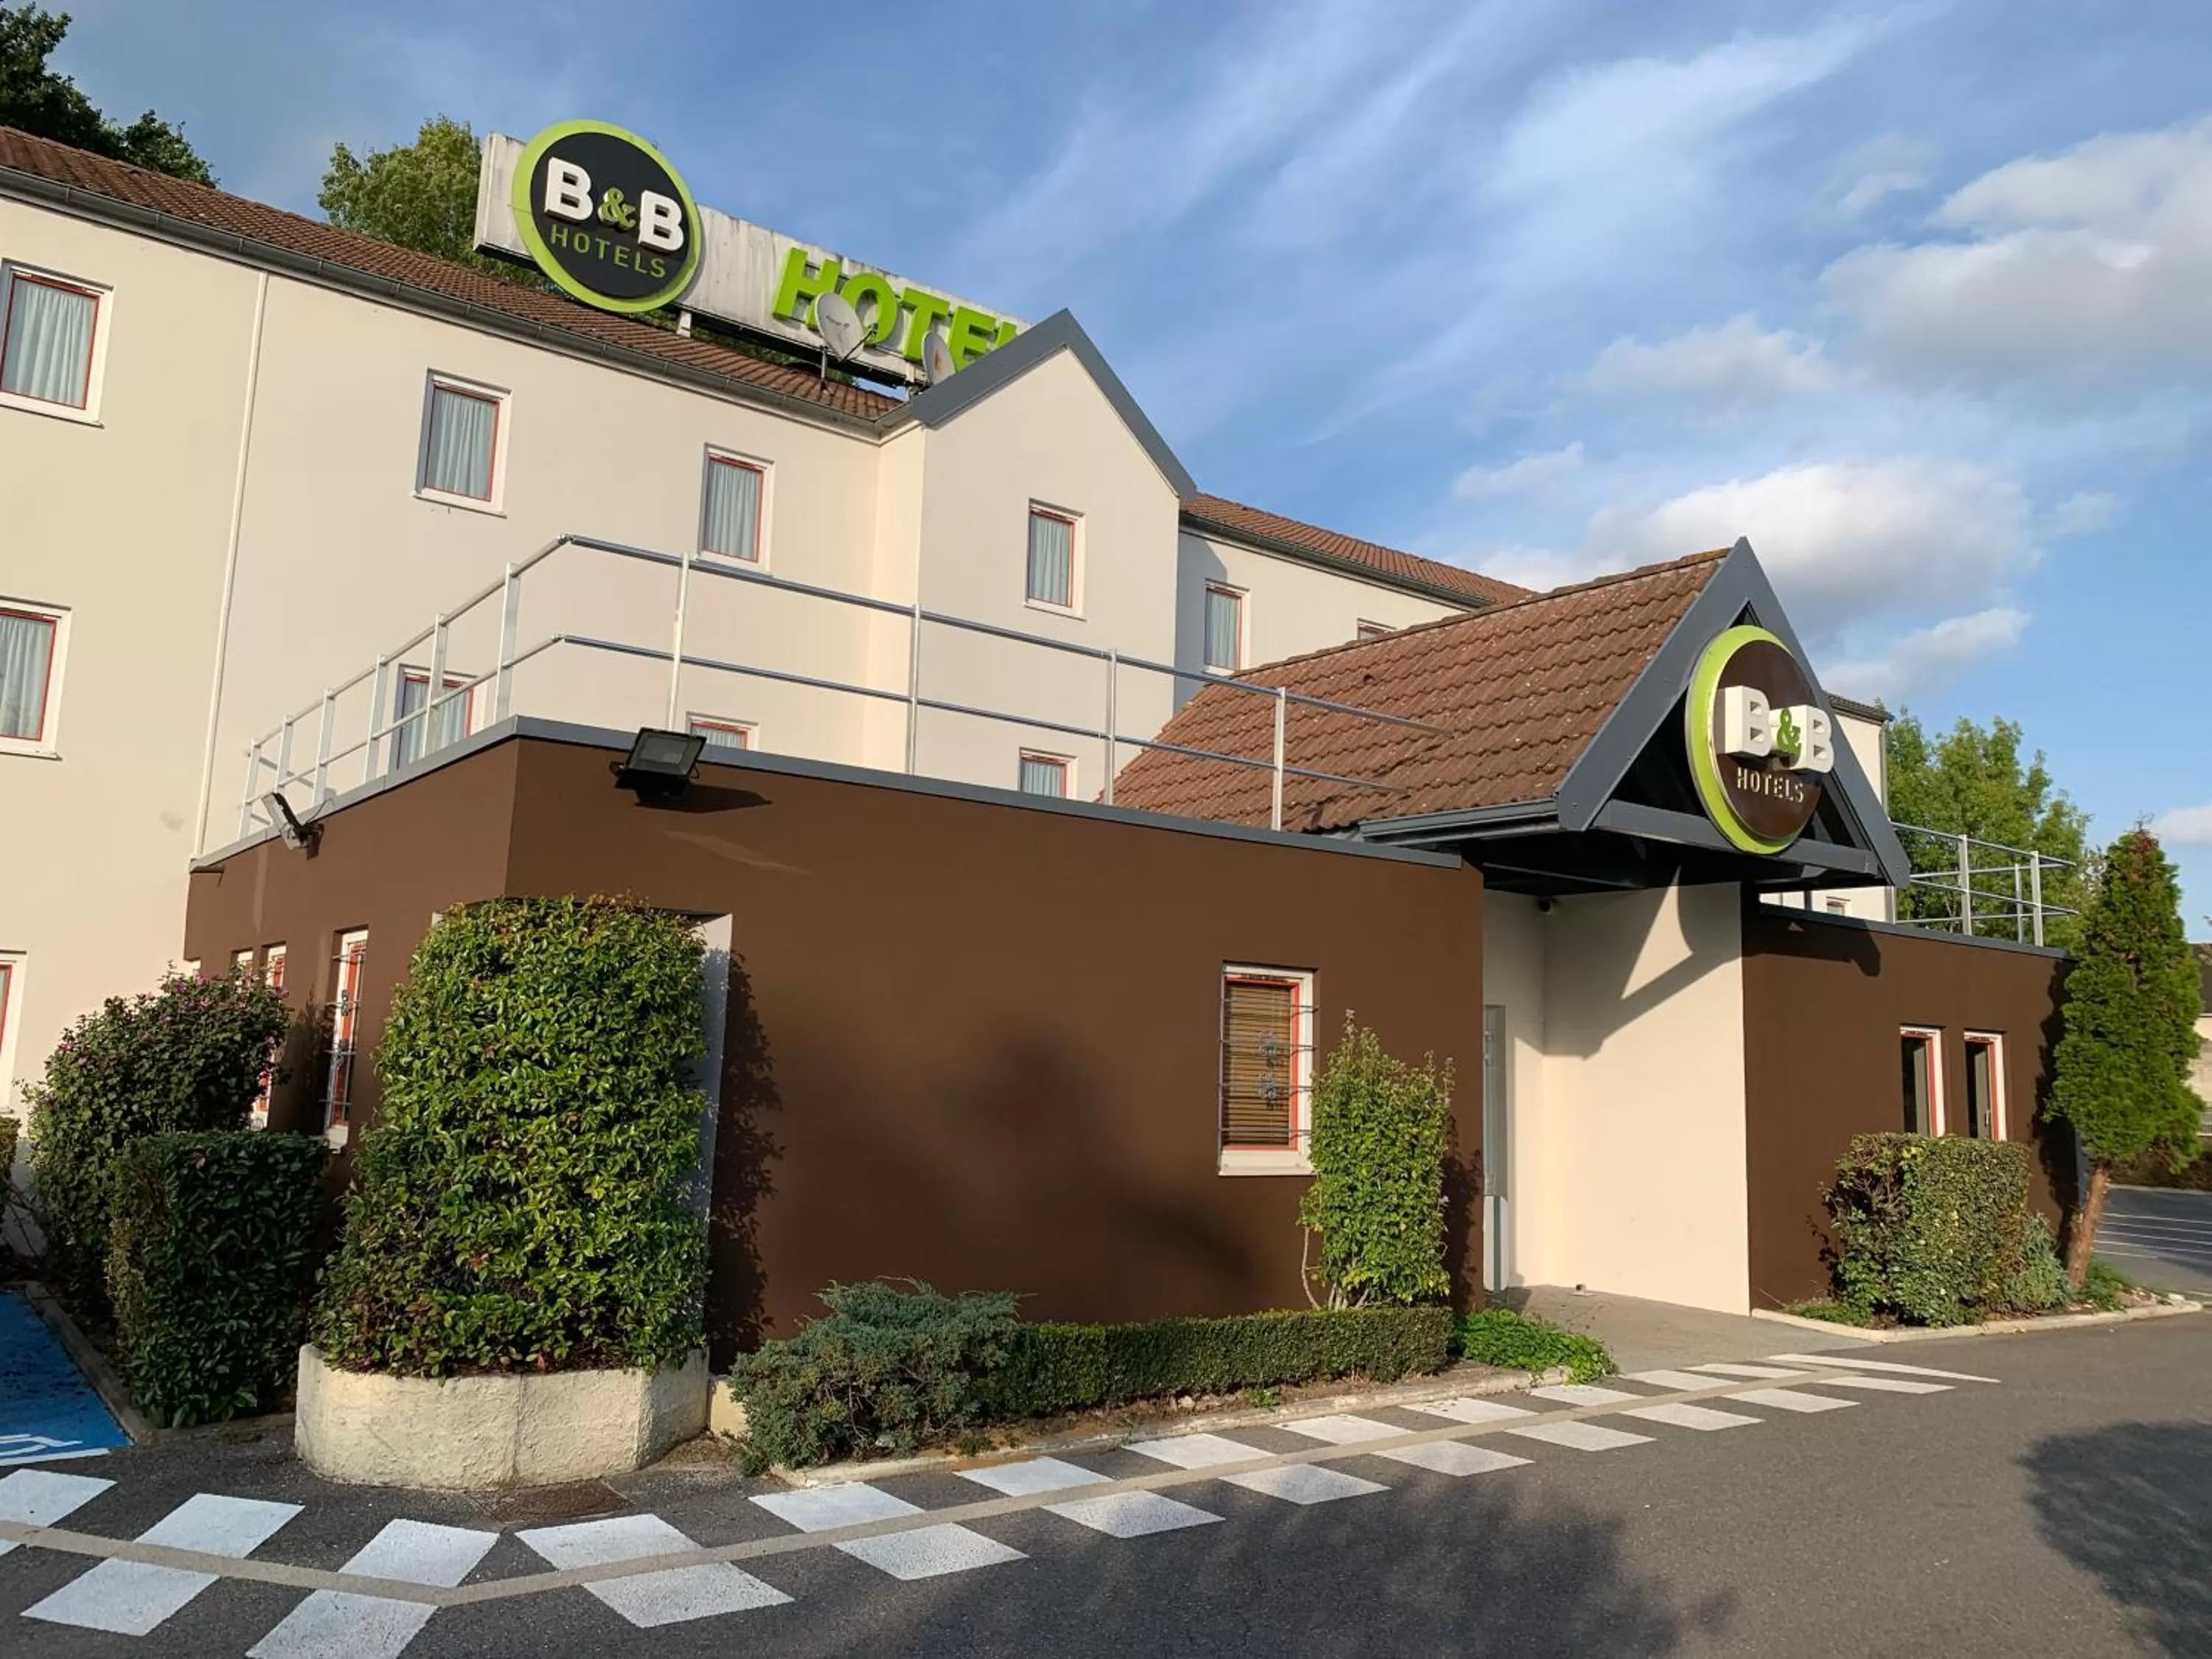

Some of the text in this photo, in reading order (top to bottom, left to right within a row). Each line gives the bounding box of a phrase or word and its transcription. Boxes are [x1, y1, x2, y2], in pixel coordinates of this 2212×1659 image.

[544, 156, 684, 252] B&B
[550, 223, 667, 279] HOTELS
[1725, 685, 1835, 773] B&B
[1736, 766, 1805, 803] HOTELS
